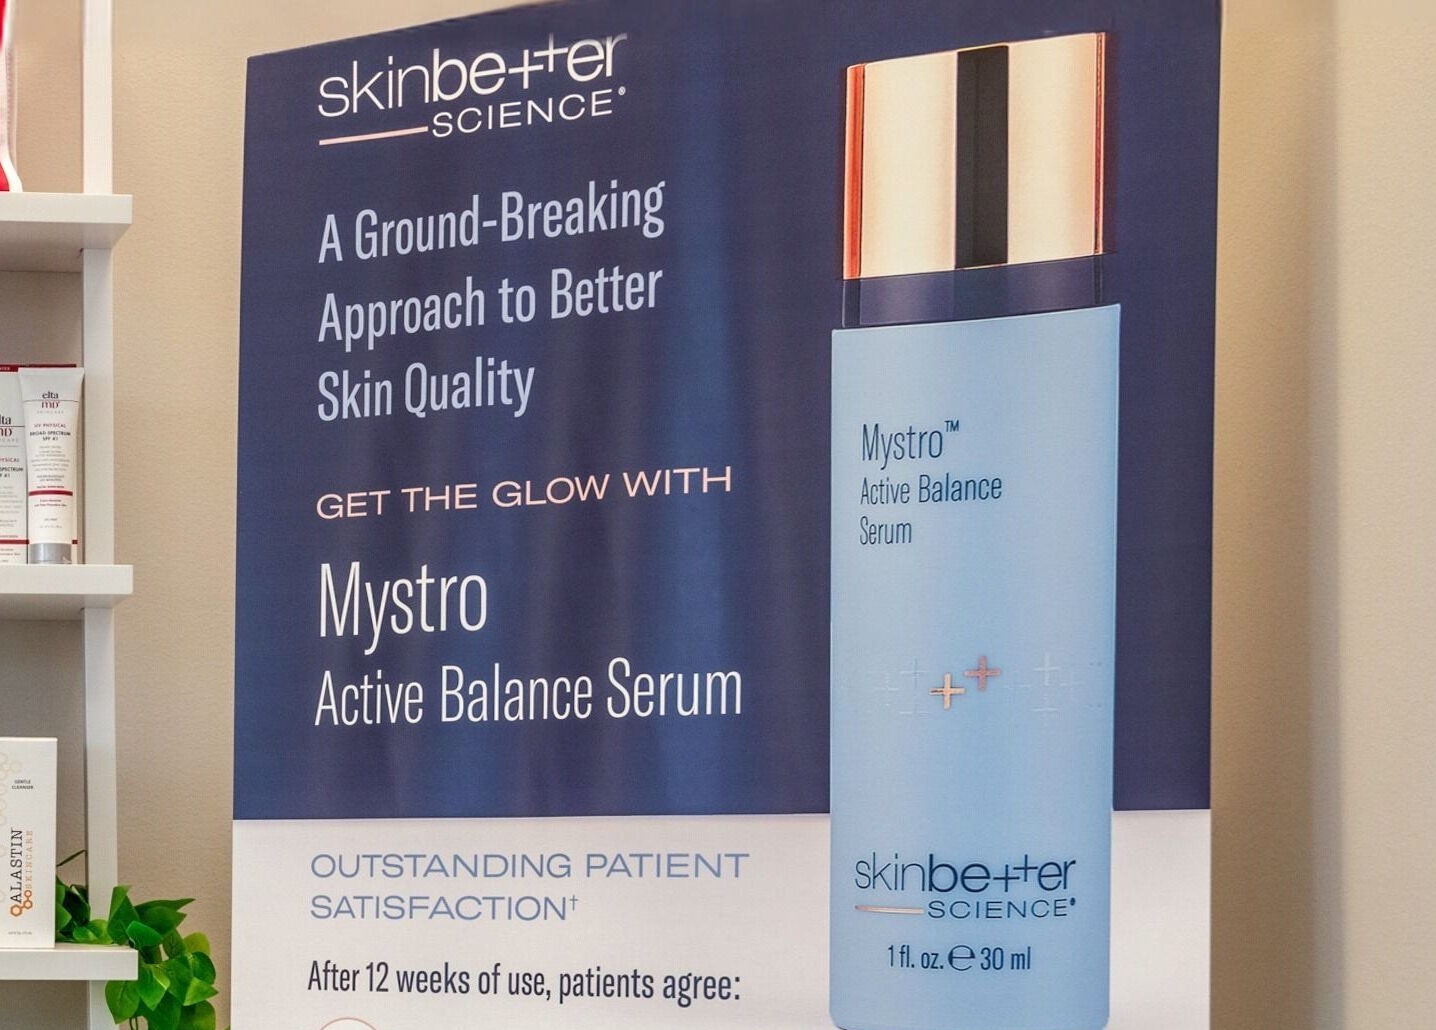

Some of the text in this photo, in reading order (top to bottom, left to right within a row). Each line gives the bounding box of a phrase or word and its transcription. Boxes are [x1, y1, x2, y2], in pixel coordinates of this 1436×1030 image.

[319, 33, 627, 118] skinbetter
[319, 180, 665, 263] A Ground-Breaking
[318, 266, 662, 352] Approach to Better
[318, 356, 534, 421] Skin Quality
[317, 466, 731, 519] GET THE GLOW WITH
[861, 473, 1002, 505] Active Balance
[860, 516, 912, 545] Serum
[321, 562, 487, 655] Mystro
[315, 657, 741, 725] Active Balance Serum
[11, 828, 23, 903] ALASTIN
[311, 853, 750, 878] OUTSTANDING PATIENT
[855, 852, 1076, 892] skinbetter
[308, 960, 740, 1008] After 12 weeks of use, patients agree:
[888, 945, 893, 967] 1
[899, 945, 914, 968] fl.
[921, 953, 943, 969] oz.
[981, 947, 1003, 970] 30
[1011, 946, 1031, 970] ml
